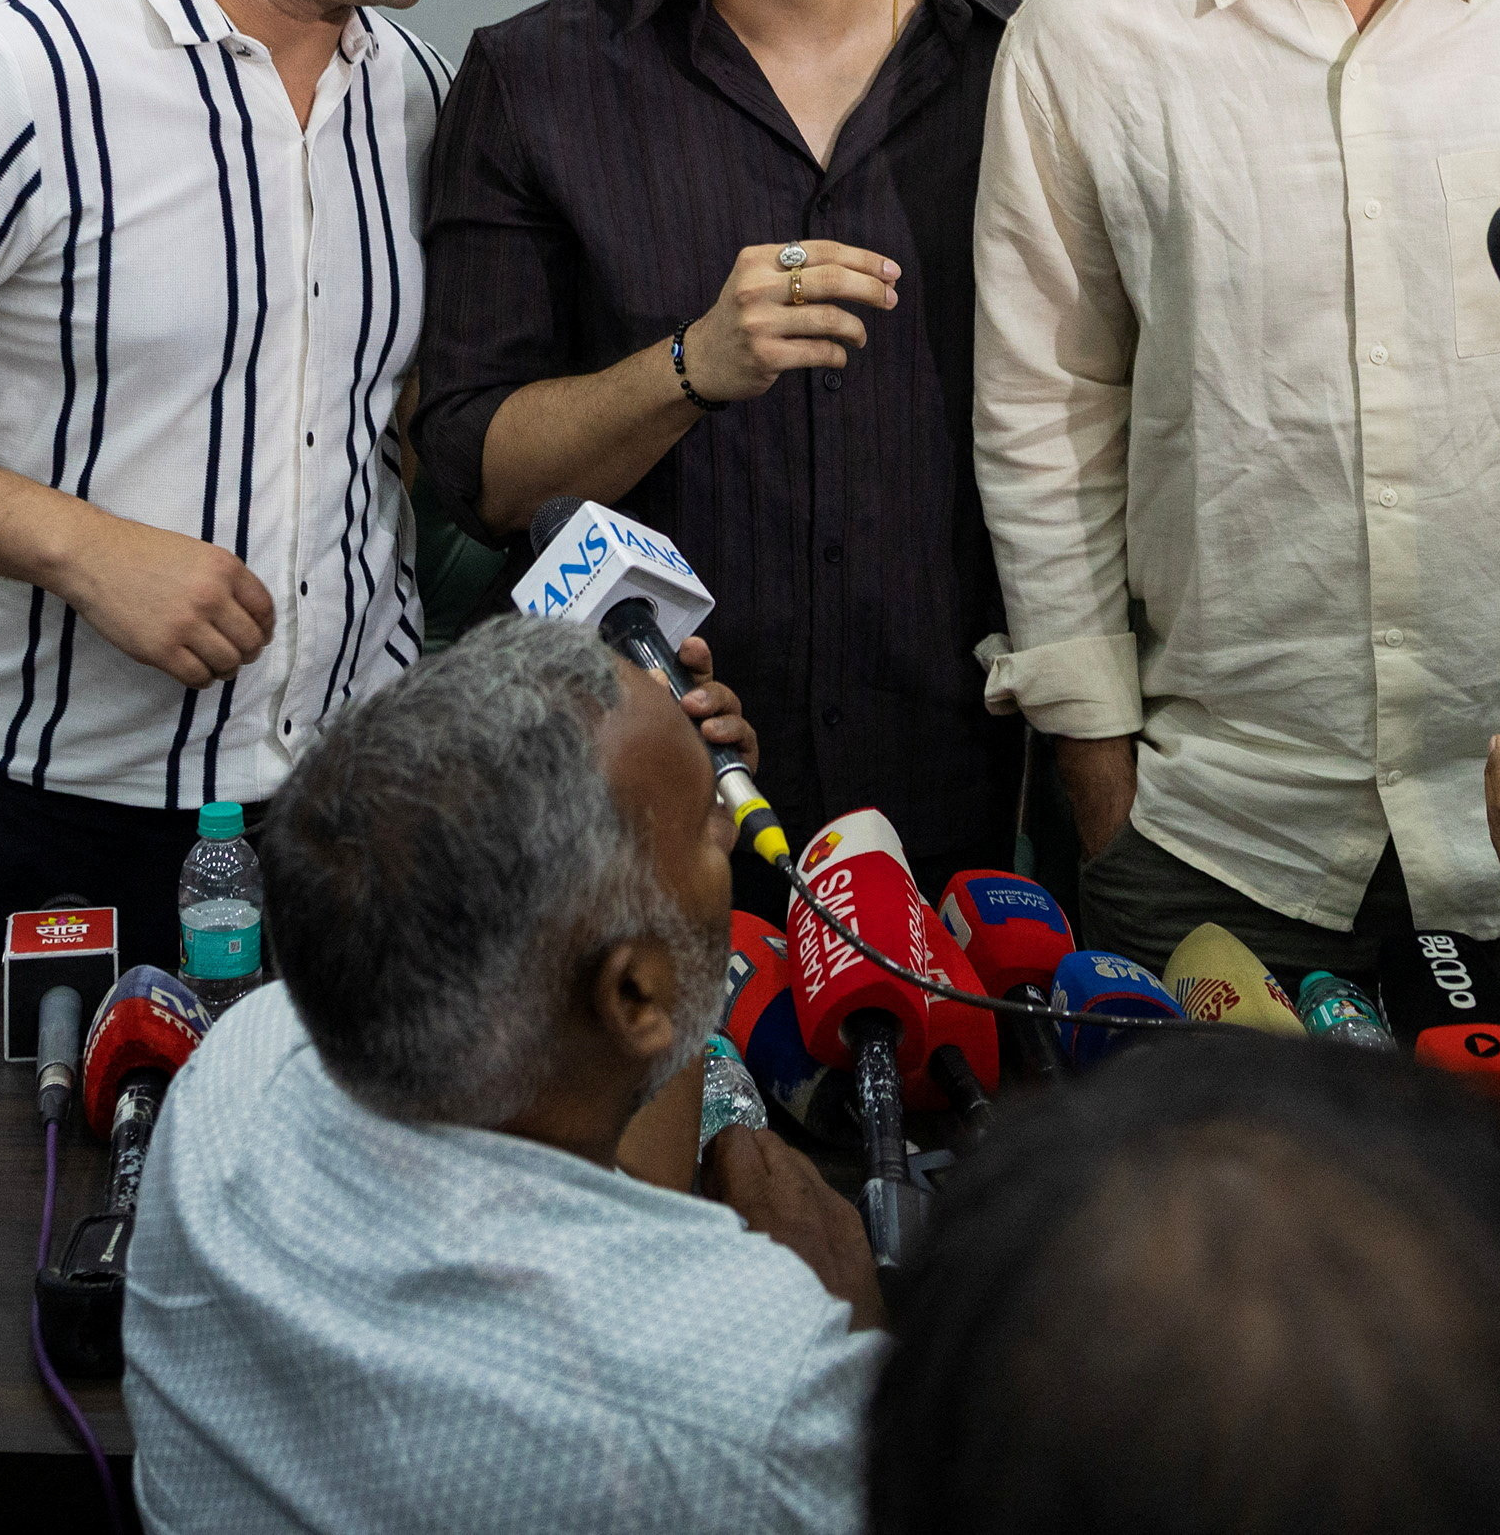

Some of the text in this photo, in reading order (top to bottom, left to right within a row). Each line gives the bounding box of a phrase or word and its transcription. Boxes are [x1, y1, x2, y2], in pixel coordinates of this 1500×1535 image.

[609, 521, 693, 576] IANS
[986, 889, 1046, 902] manorama
[989, 895, 1050, 911] NEWS
[35, 923, 90, 936] साम
[816, 868, 864, 979] NEWS
[41, 936, 84, 945] NEWS
